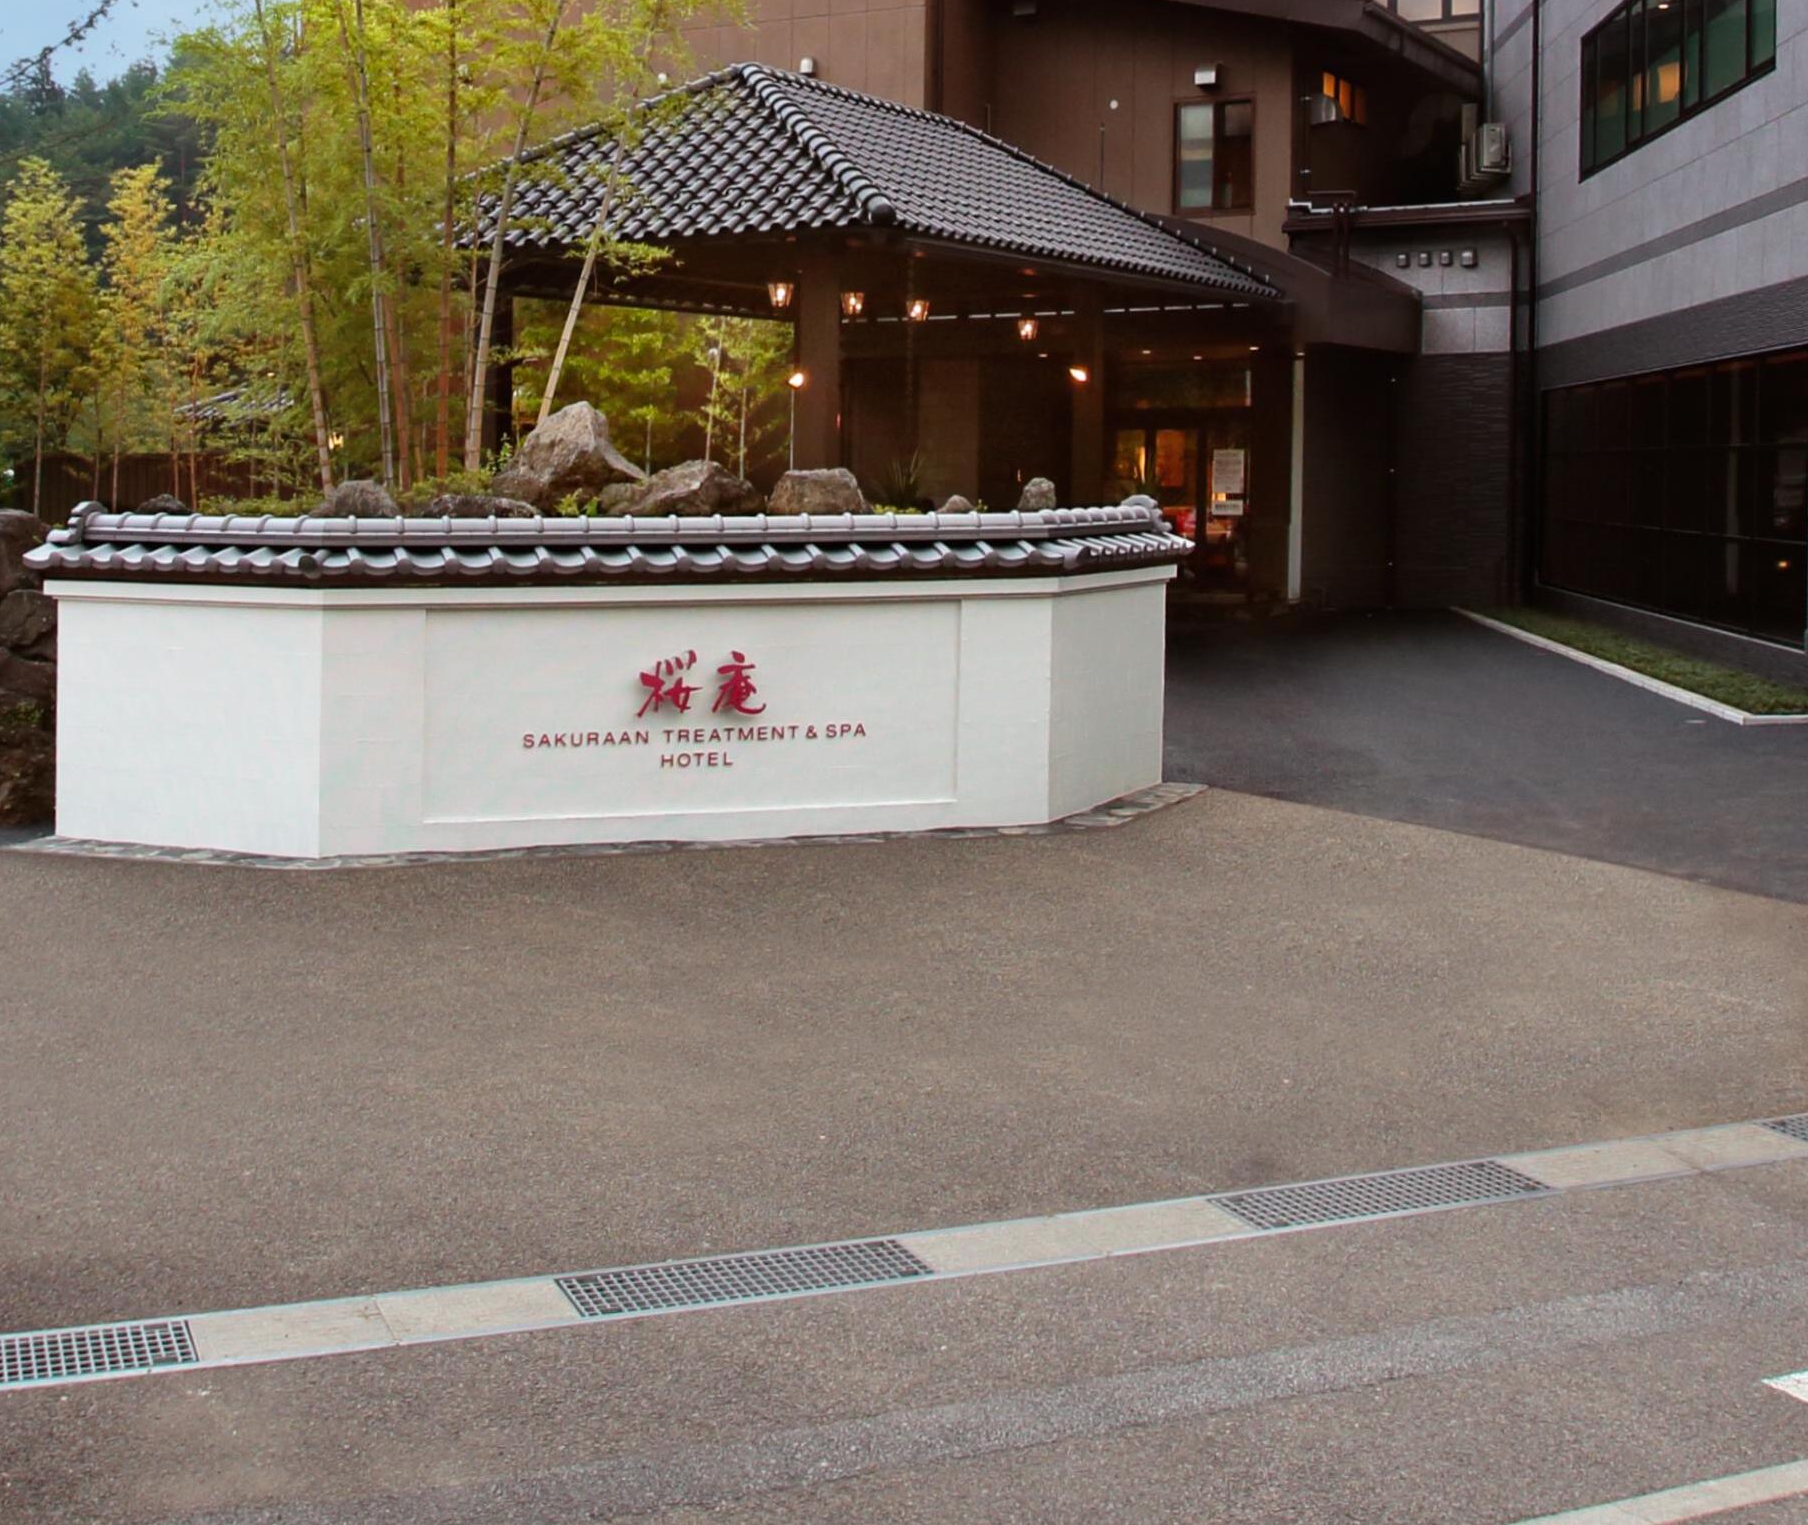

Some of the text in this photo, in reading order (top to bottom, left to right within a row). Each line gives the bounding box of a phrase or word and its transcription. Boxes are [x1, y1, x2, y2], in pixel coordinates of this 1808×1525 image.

[522, 730, 650, 749] SAKURAAN
[663, 725, 798, 744] TREATMENT
[825, 722, 867, 738] SPA
[660, 751, 734, 768] HOTEL
